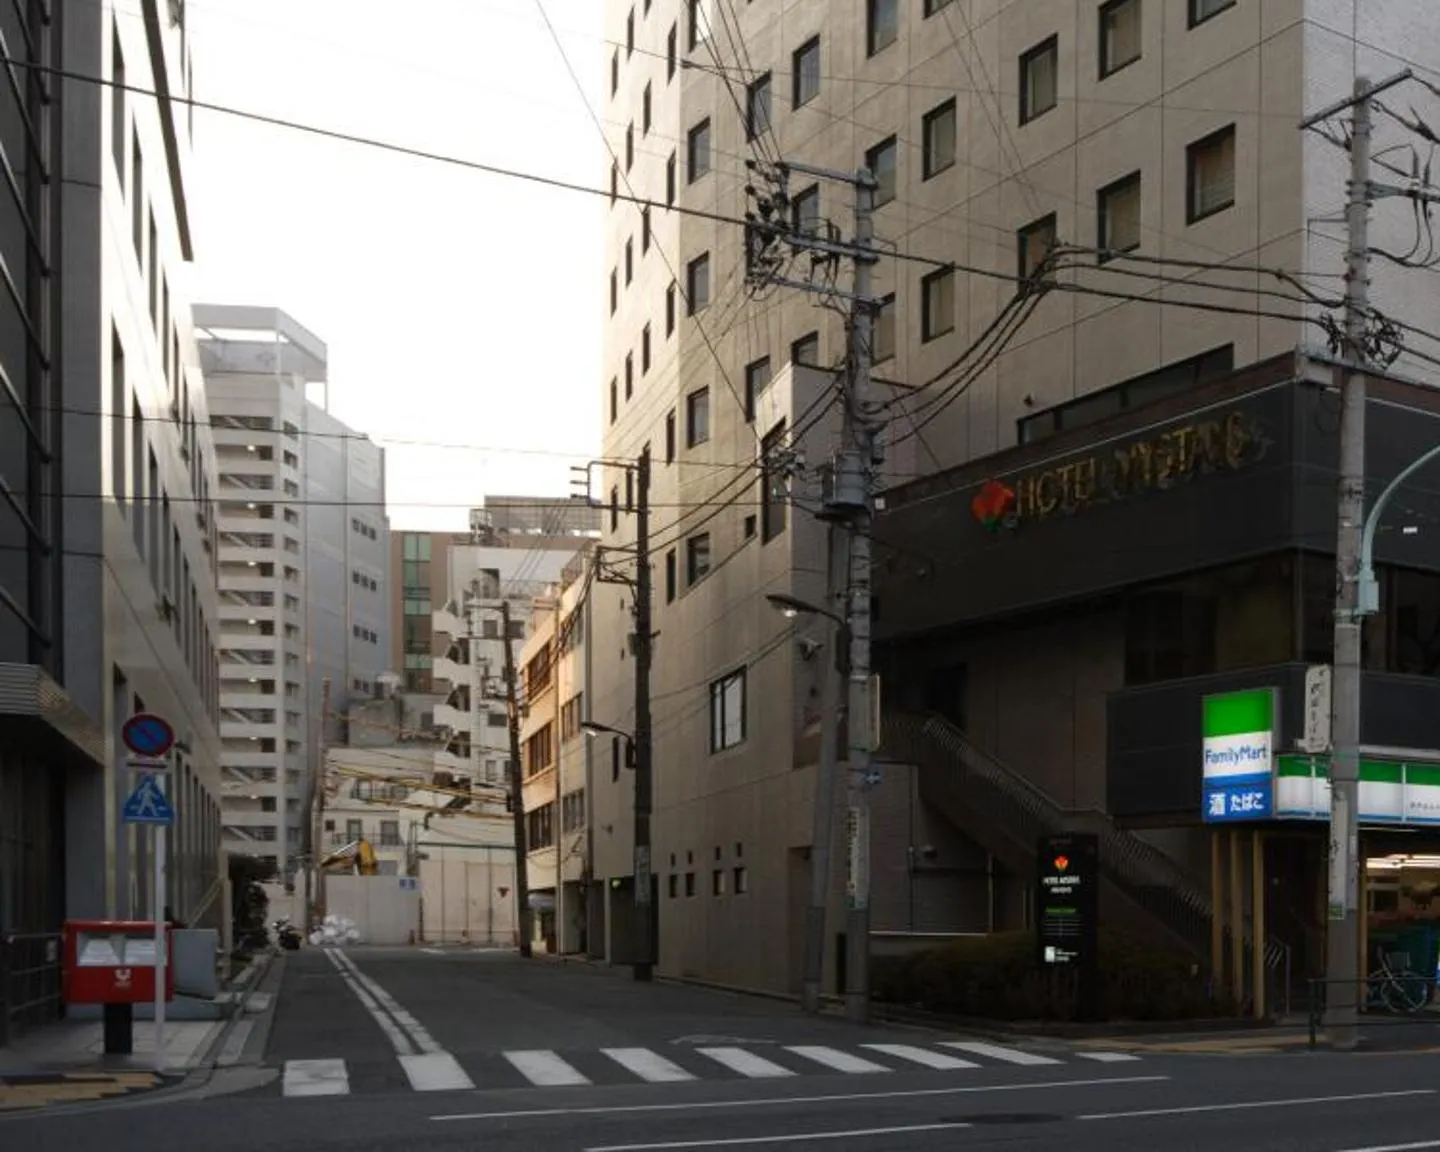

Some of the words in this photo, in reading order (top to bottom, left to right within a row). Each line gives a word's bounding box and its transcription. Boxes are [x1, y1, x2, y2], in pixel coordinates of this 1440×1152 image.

[1205, 745, 1267, 765] FamilyMart
[1230, 792, 1265, 813] たばこ
